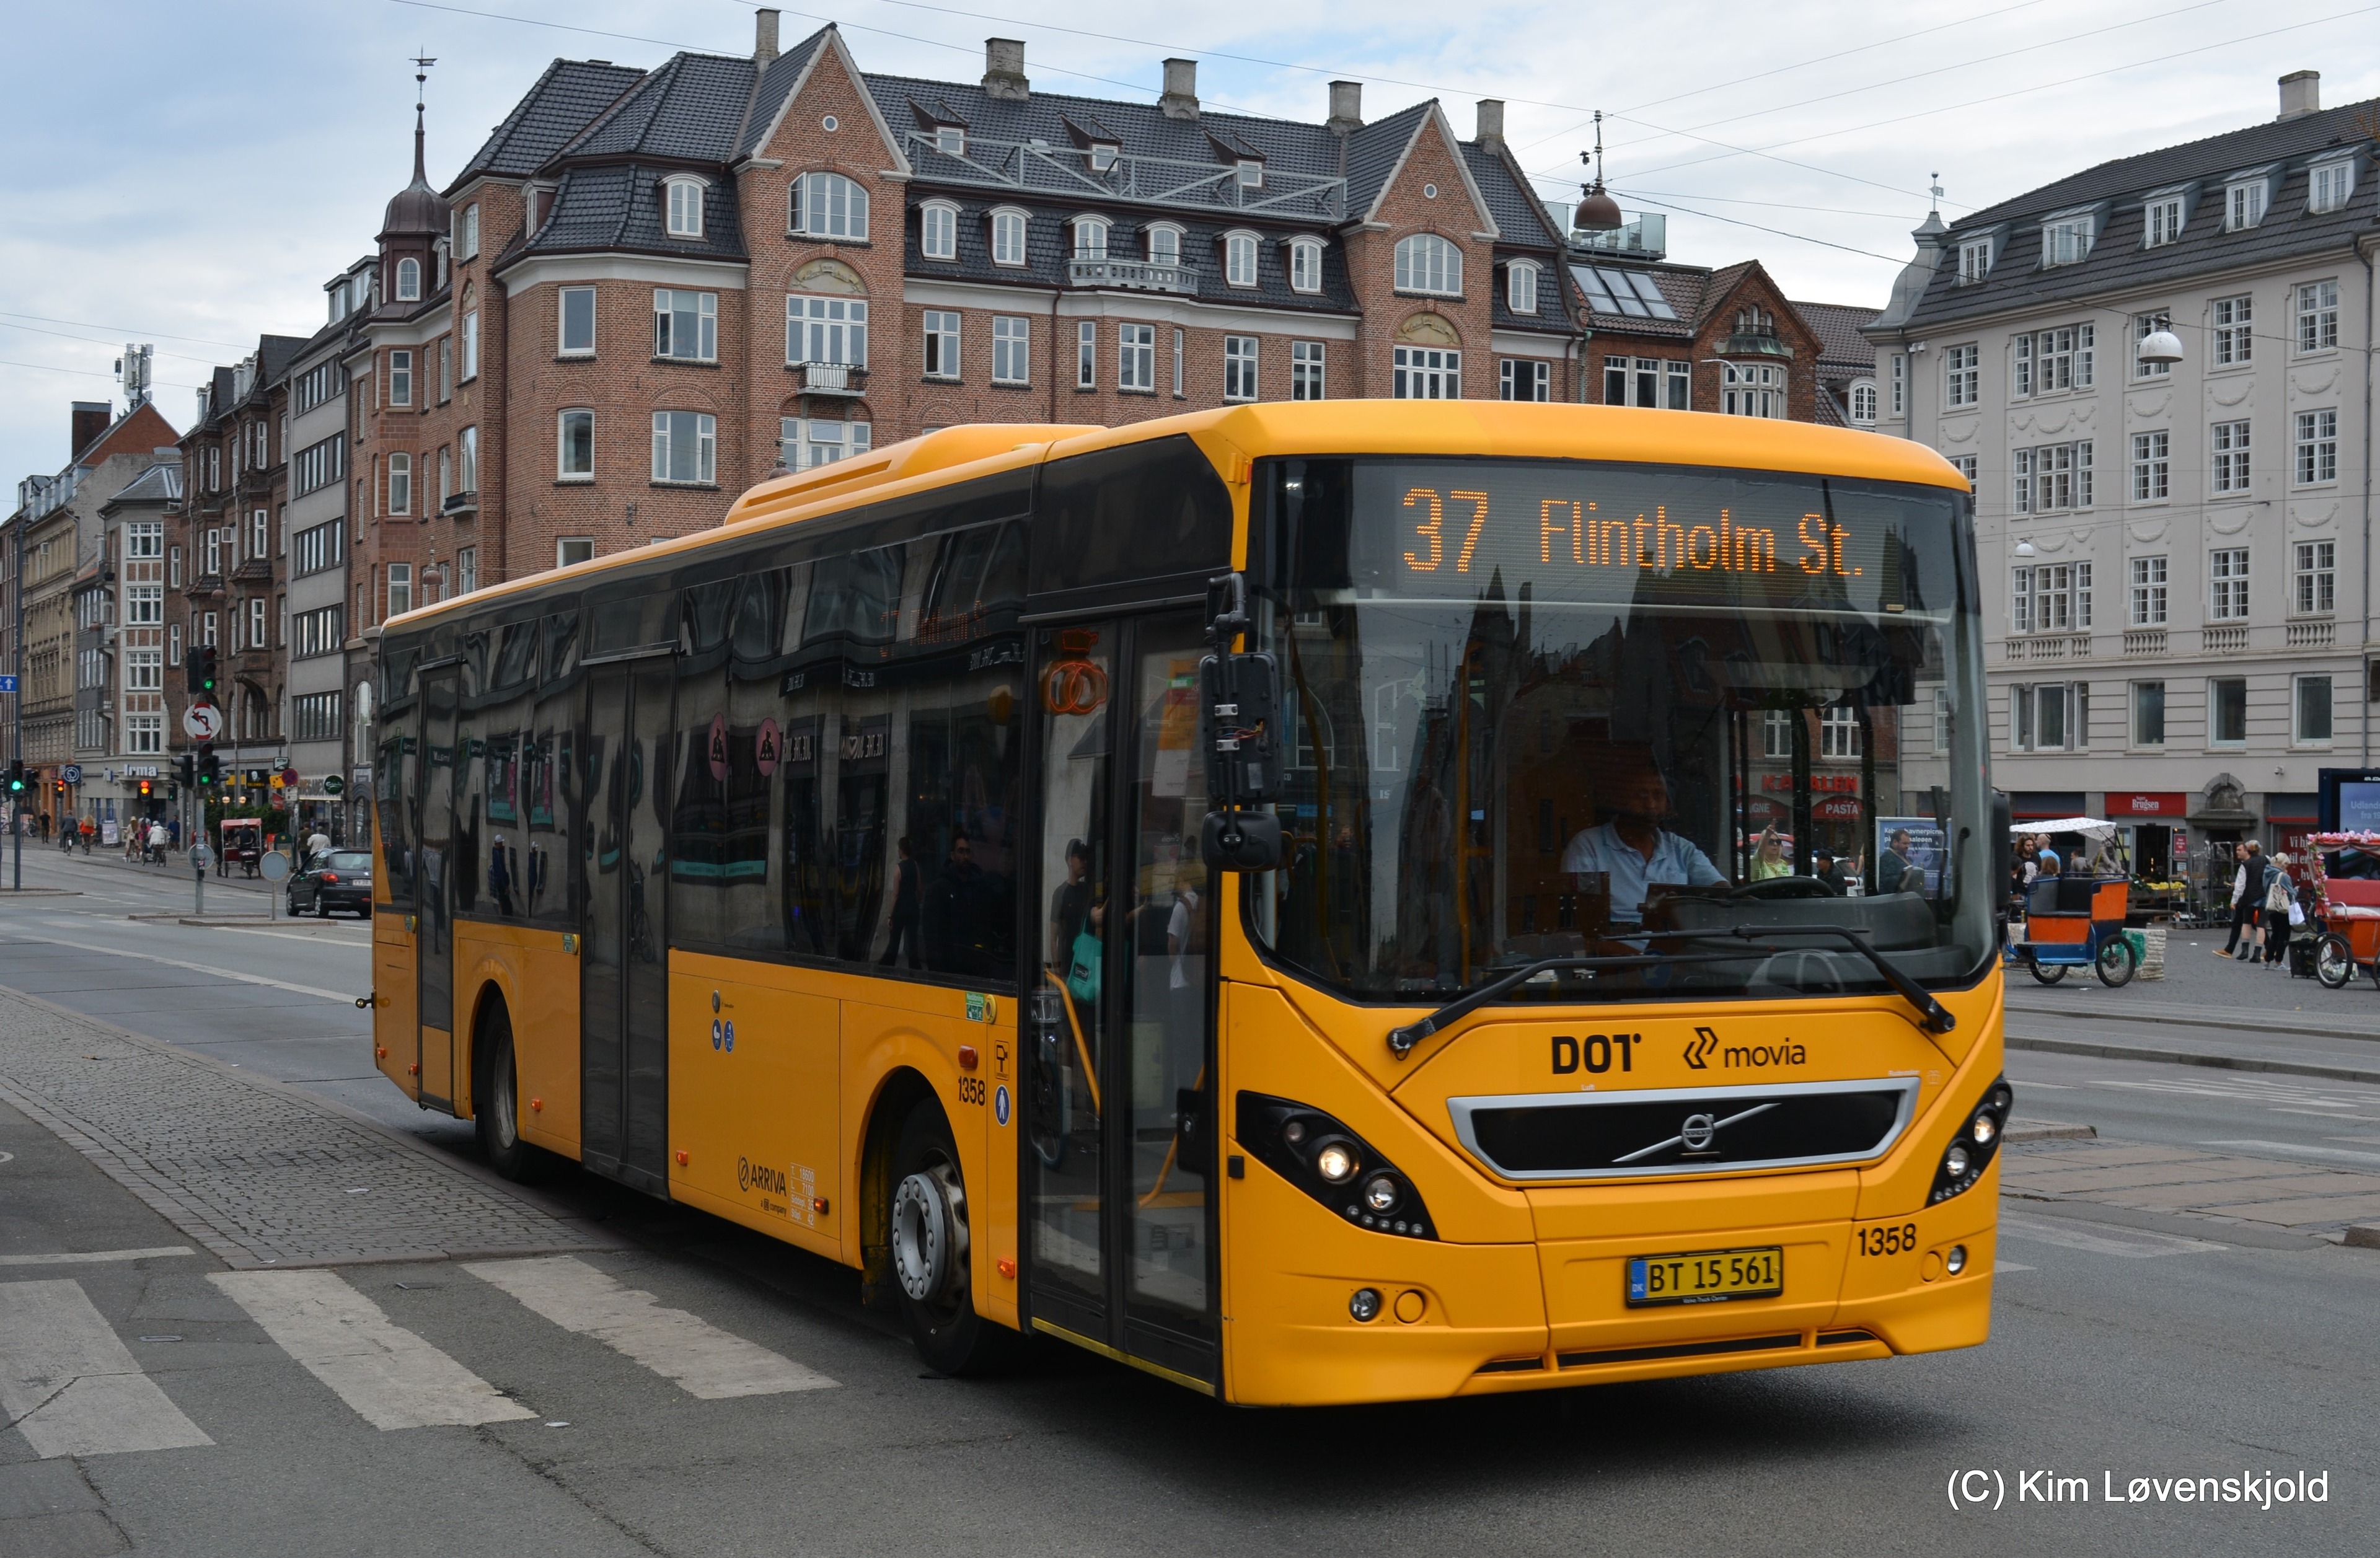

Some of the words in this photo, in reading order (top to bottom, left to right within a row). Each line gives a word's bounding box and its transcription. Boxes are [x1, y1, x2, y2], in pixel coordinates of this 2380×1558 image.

[1403, 488, 1488, 572] 37
[1541, 500, 1775, 572] Flintholm
[1798, 513, 1862, 576] St.
[124, 764, 157, 777] Irma
[1762, 774, 1858, 791] KAALEN
[1825, 804, 1859, 814] PASTA
[2132, 799, 2159, 811] Brugsen
[2290, 836, 2298, 848] Vi
[1552, 1033, 1641, 1075] DOT
[1724, 1037, 1806, 1068] movia
[958, 1076, 985, 1106] 1358
[751, 1164, 787, 1197] ARRIVA
[802, 1182, 814, 1197] 7100
[770, 1203, 787, 1217] company
[808, 1199, 814, 1211] 35
[808, 1213, 814, 1226] 42
[1858, 1223, 1916, 1256] 1358
[1649, 1262, 1683, 1292] BT
[1695, 1259, 1721, 1288] 15
[1730, 1256, 1774, 1286] 561
[1632, 1283, 1644, 1293] DK
